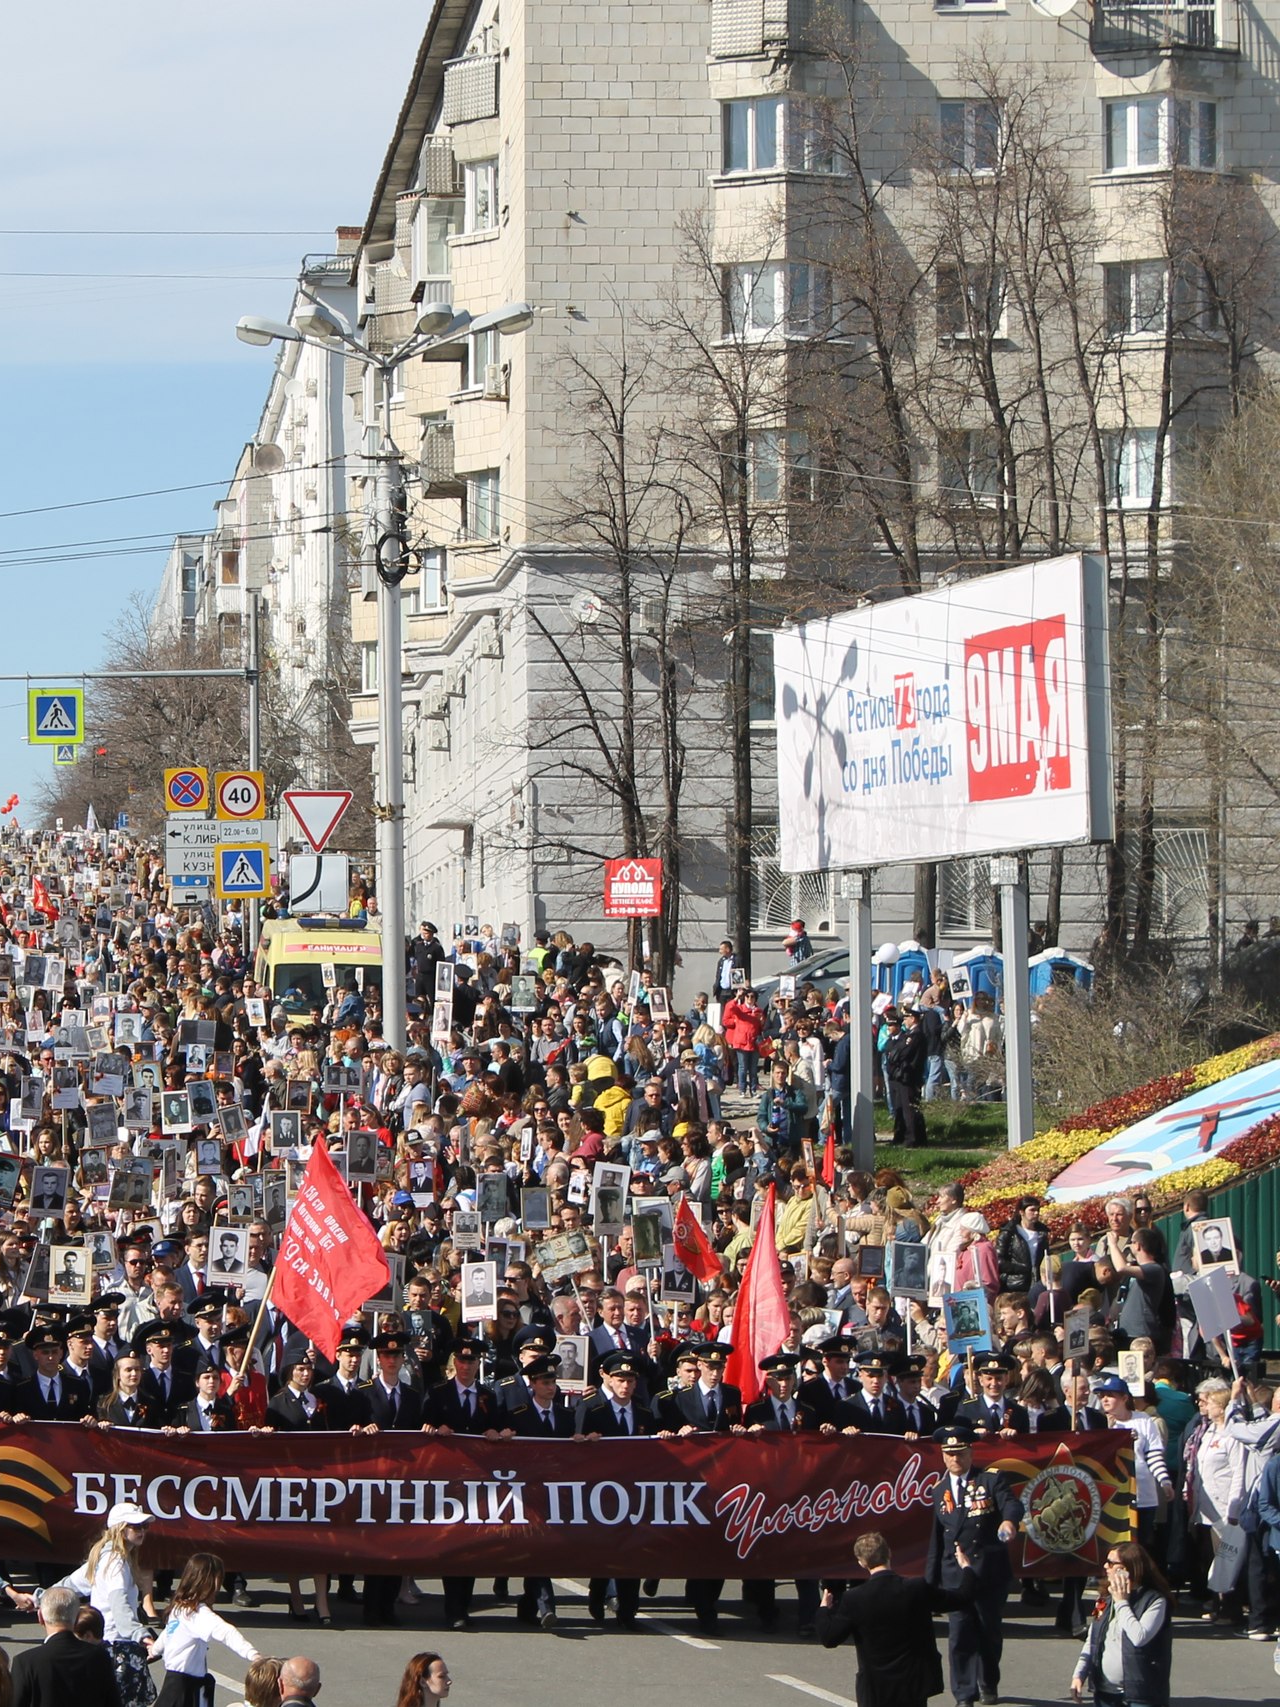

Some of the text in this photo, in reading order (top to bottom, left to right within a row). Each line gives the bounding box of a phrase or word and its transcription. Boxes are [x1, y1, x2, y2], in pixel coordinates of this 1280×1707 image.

[847, 677, 950, 734] Регион 73 года
[842, 735, 952, 796] со дня Победы
[228, 787, 252, 805] 40
[183, 824, 216, 832] улица
[183, 862, 215, 872] КУЗН
[611, 882, 654, 894] КУПОЛА
[323, 1214, 349, 1244] ОРДЕНА
[72, 1469, 711, 1526] БЕССМЕРТНЫЙ ПОЛК
[715, 1453, 944, 1559] Ульяновс
